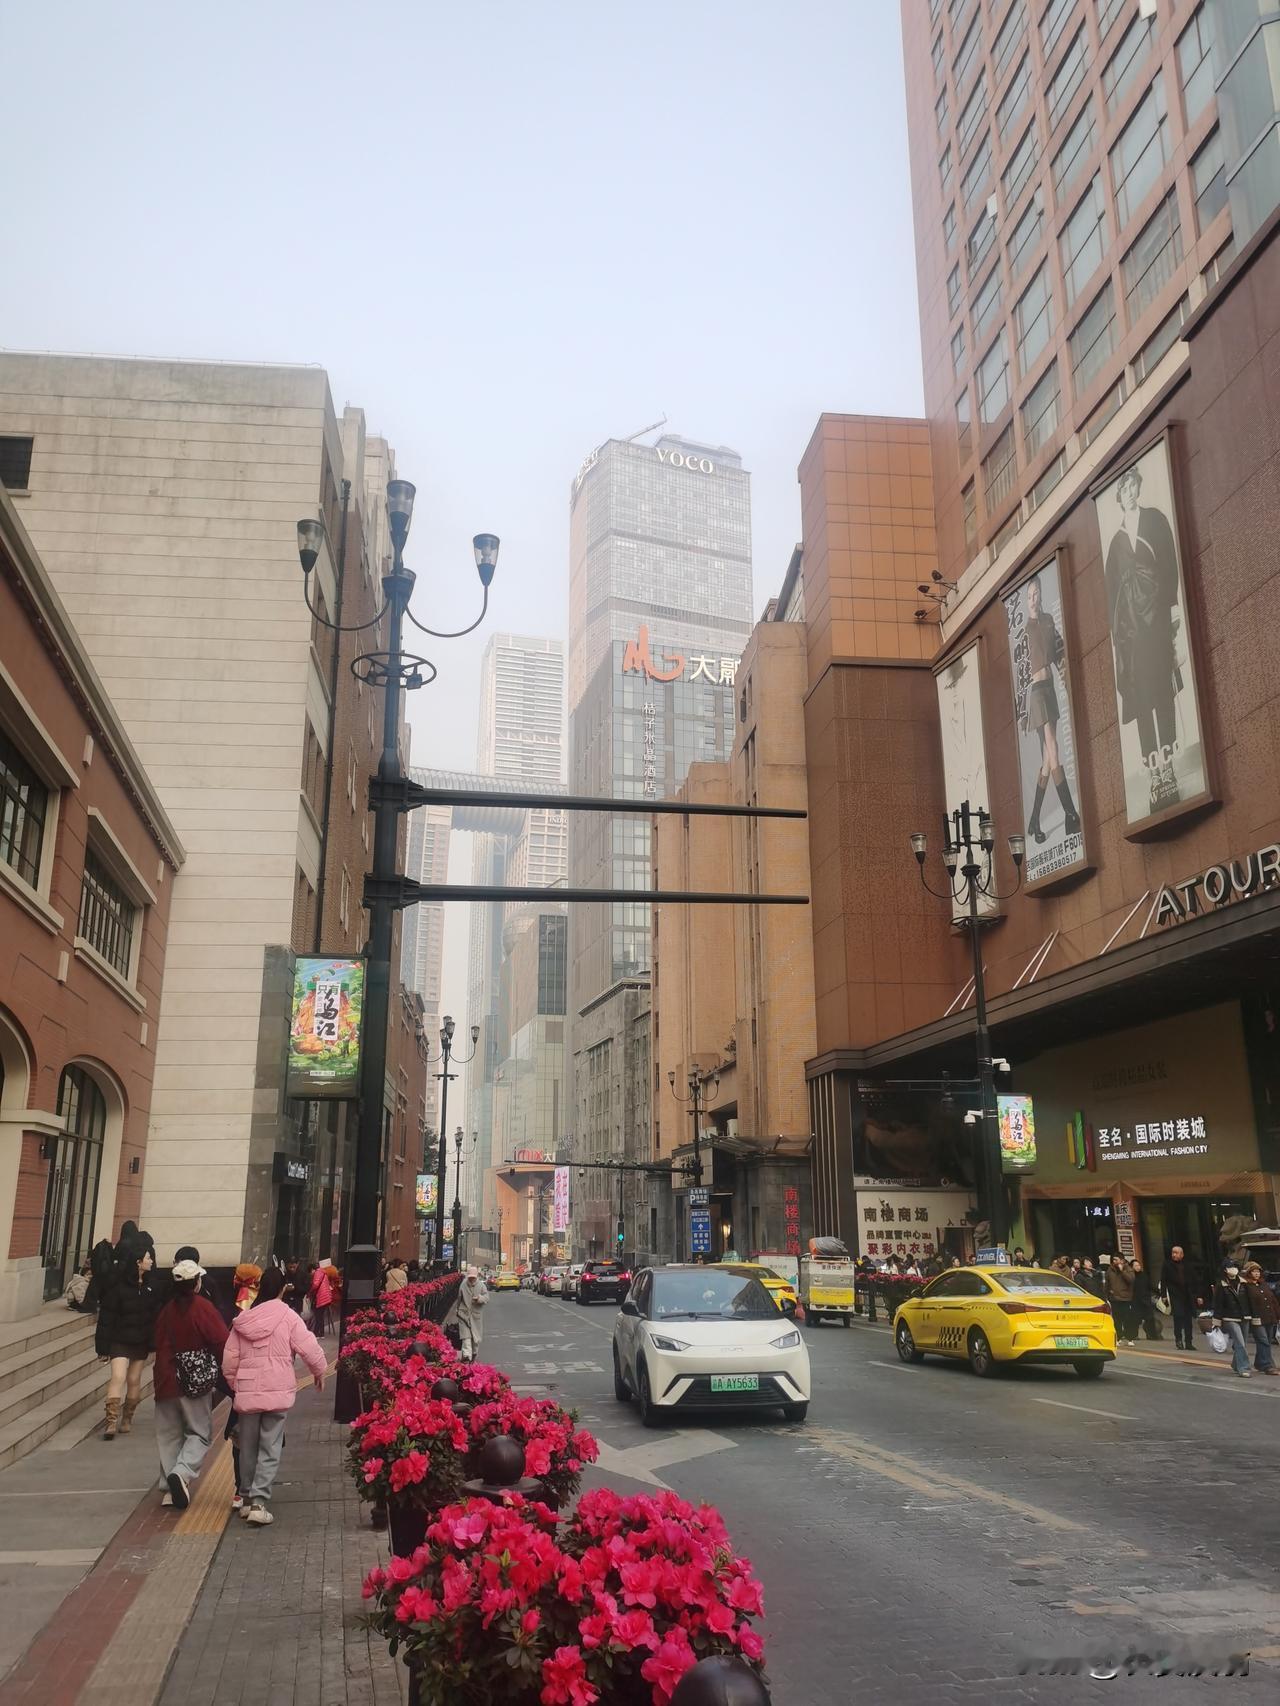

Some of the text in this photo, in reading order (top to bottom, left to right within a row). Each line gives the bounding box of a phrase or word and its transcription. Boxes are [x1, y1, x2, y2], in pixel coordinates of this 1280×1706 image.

[643, 702, 657, 794] 桔子水晶酒店
[1155, 844, 1280, 924] ATOUR
[1098, 1116, 1207, 1148] 圣名·国际时装城
[1130, 1147, 1169, 1159] INTERNATIONAL
[1170, 1145, 1195, 1156] FASHION
[784, 1187, 800, 1254] 南楼商场
[863, 1207, 929, 1223] 南楼商场
[726, 1377, 758, 1389] AY5633
